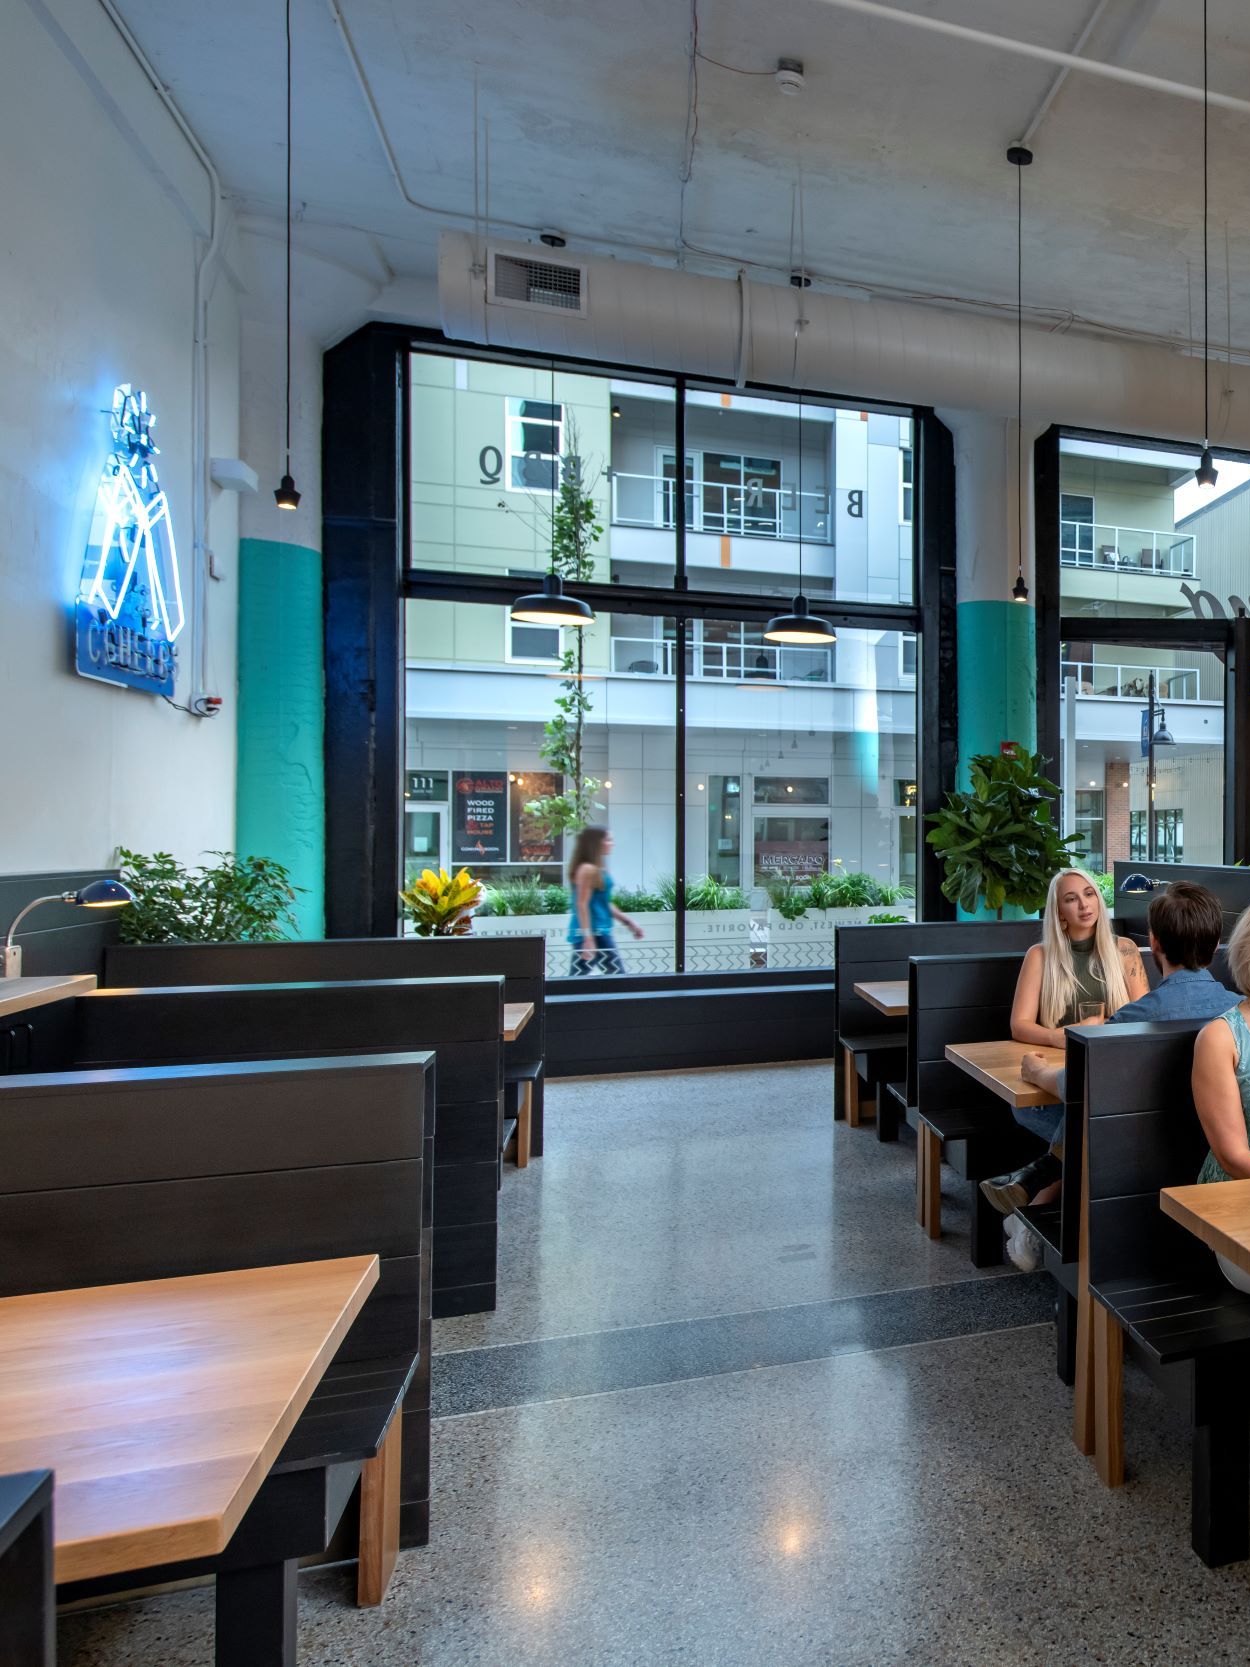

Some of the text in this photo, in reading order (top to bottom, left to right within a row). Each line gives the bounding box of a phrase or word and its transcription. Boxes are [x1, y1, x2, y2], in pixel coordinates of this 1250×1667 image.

[412, 777, 434, 789] 111
[466, 799, 495, 807] WOOD
[761, 855, 824, 865] MERCADO
